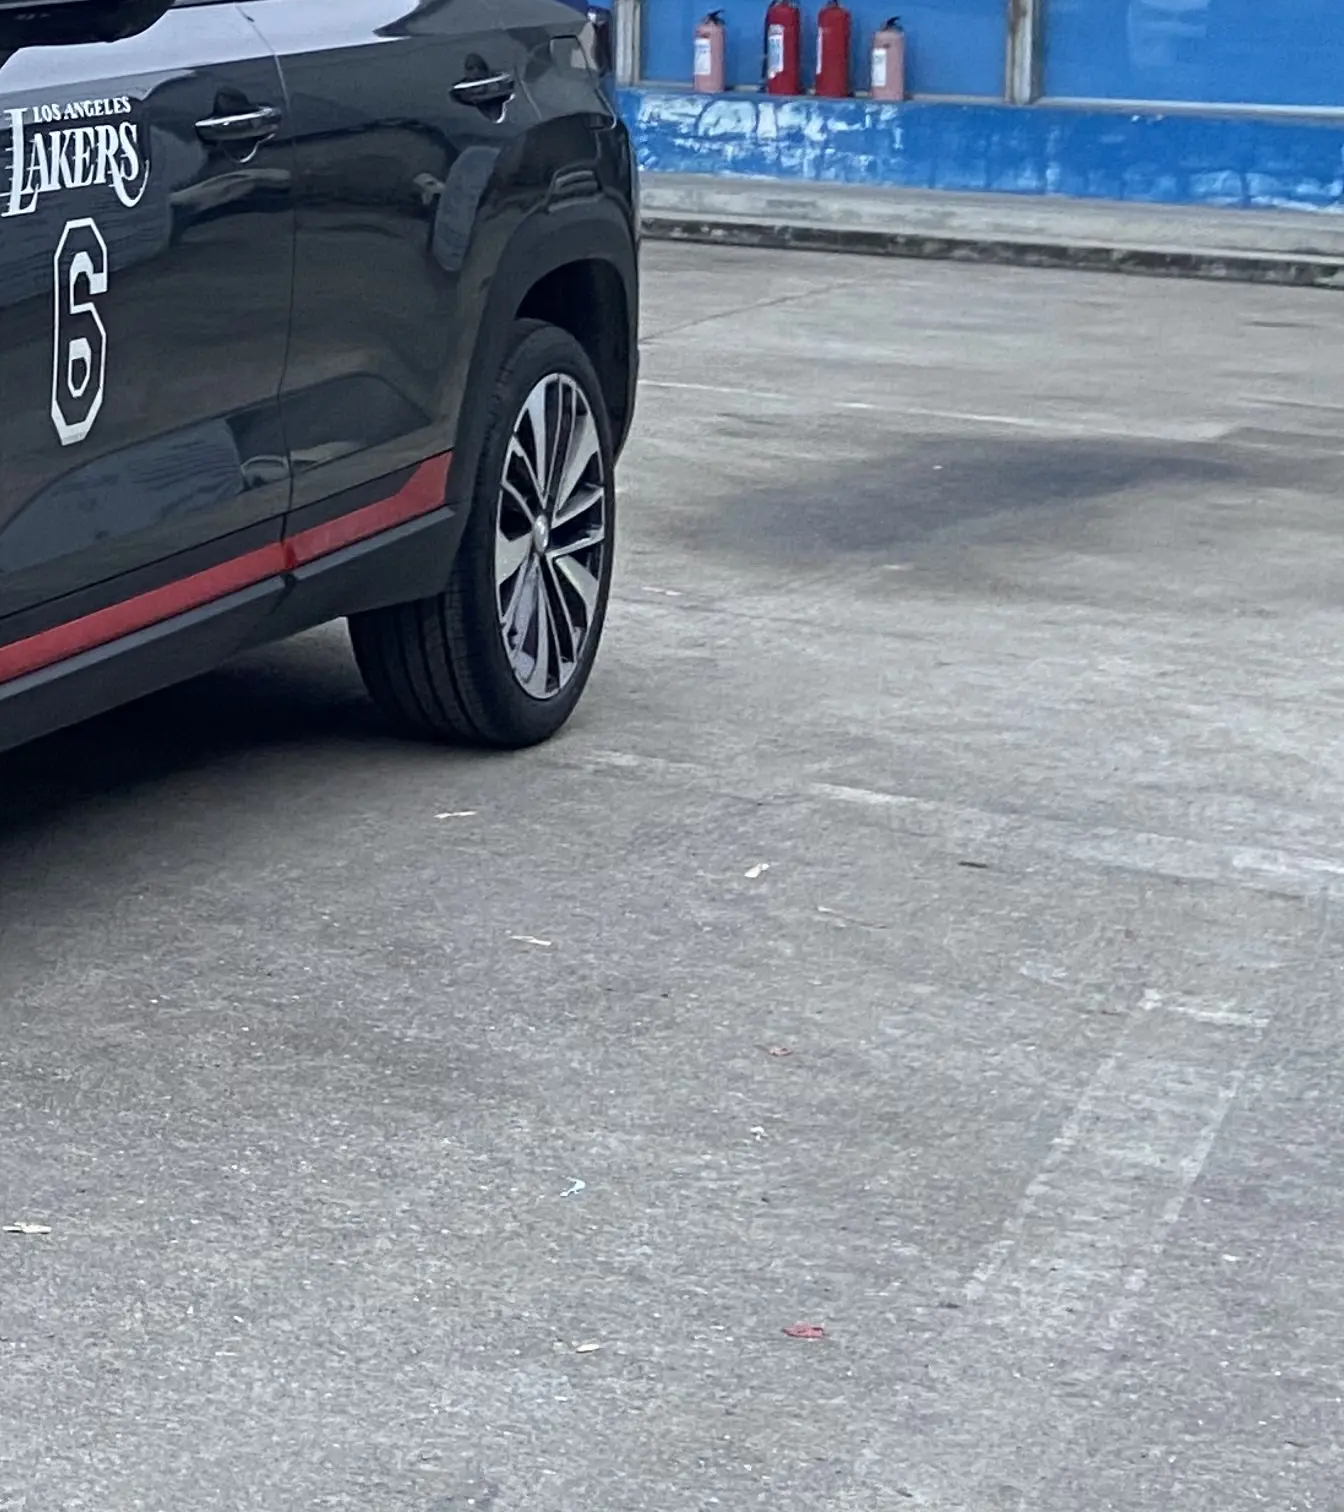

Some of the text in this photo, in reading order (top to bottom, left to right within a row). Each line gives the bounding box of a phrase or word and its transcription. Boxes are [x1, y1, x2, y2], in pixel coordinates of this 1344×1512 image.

[32, 96, 132, 123] LOS ANGELES
[51, 217, 108, 446] 6
